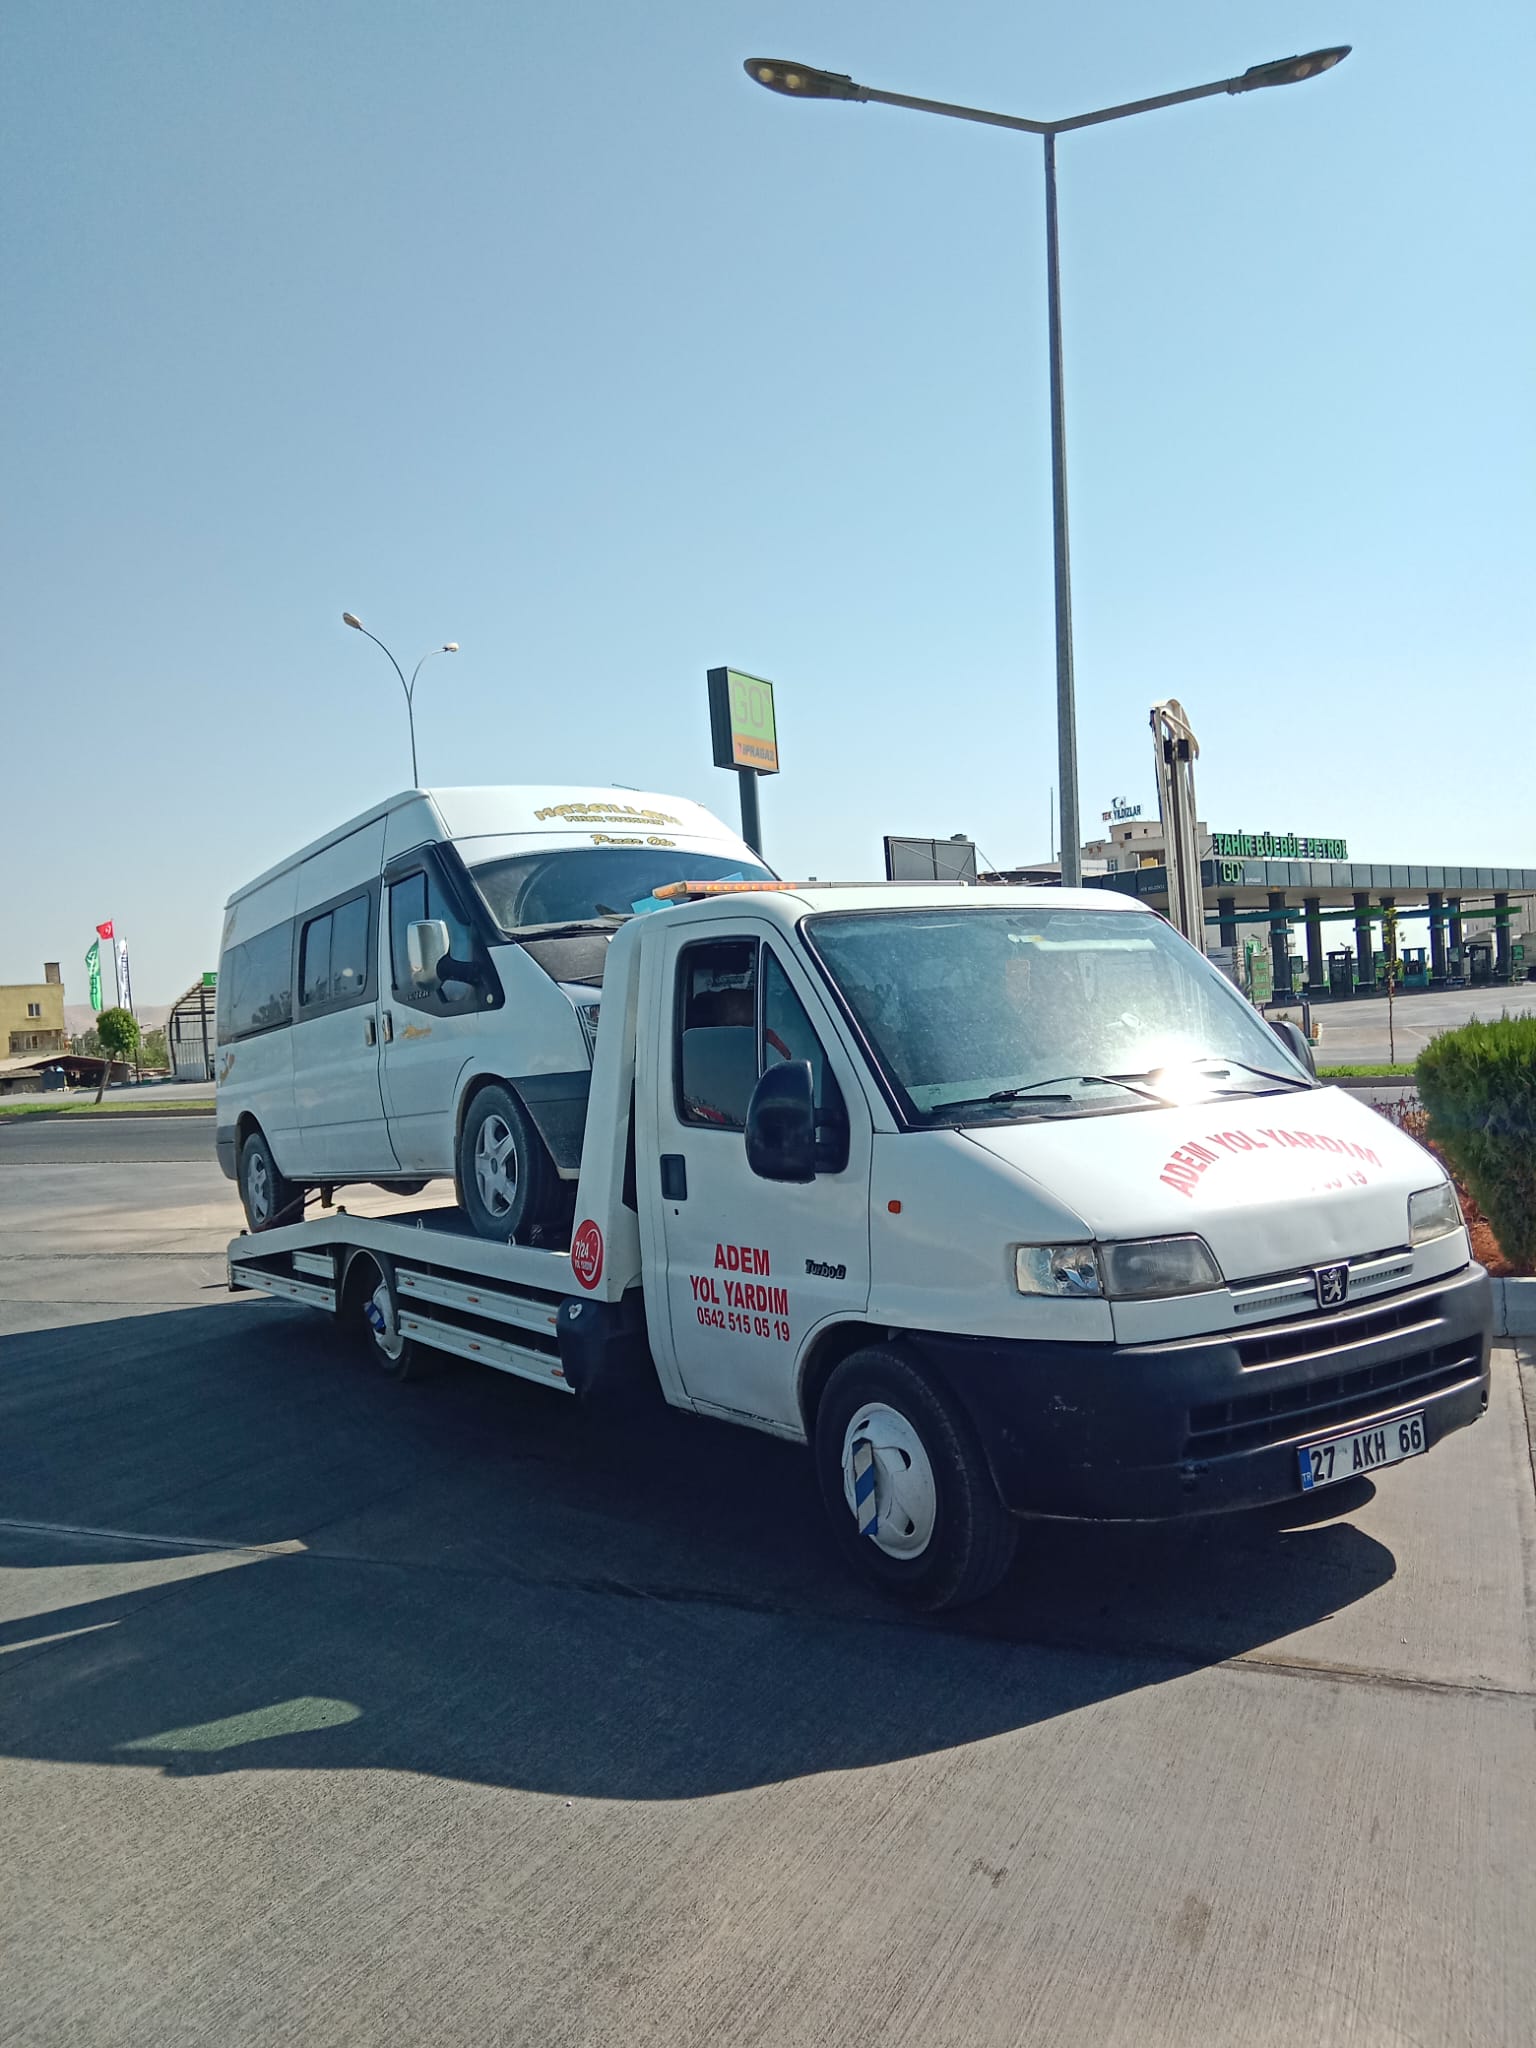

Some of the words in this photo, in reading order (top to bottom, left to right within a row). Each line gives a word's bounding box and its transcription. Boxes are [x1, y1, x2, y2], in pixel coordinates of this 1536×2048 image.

[1215, 829, 1254, 857] TAHİR
[1307, 838, 1348, 859] PETROL
[1159, 1141, 1219, 1198] ADEM
[1206, 1130, 1267, 1153] YOL
[1257, 1129, 1383, 1168] YARDIM
[575, 1240, 589, 1259] 7/24
[714, 1243, 770, 1276] ADEM
[690, 1275, 720, 1305] YOL
[723, 1281, 789, 1316] YARDIM
[697, 1307, 726, 1330] 0542
[728, 1315, 751, 1334] 515
[754, 1321, 770, 1338] 05
[774, 1321, 790, 1342] 19
[1311, 1446, 1335, 1482] 27
[1353, 1430, 1387, 1470] AKH
[1398, 1420, 1421, 1453] 66
[1302, 1472, 1312, 1482] TR
